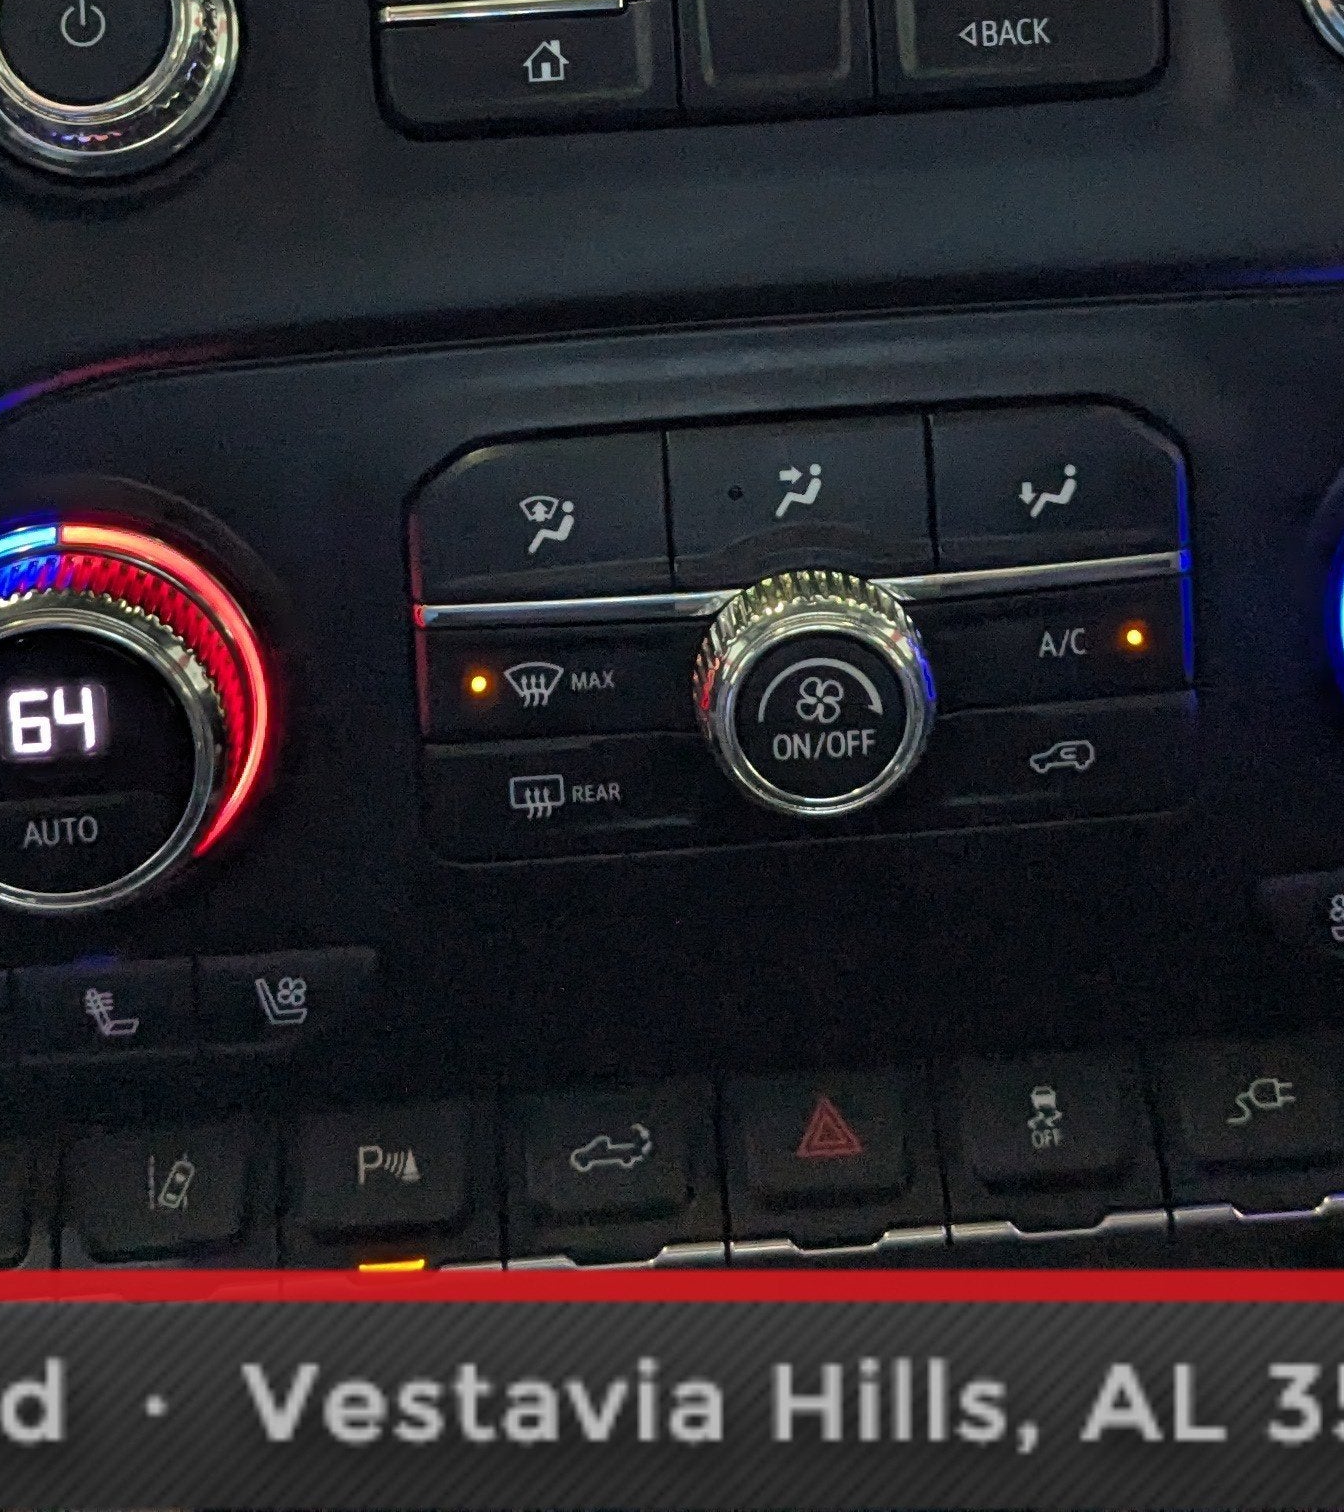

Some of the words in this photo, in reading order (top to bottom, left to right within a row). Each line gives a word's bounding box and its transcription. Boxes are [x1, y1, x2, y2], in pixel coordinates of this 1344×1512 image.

[981, 17, 1051, 47] BACK
[1039, 627, 1087, 658] A/C
[571, 670, 616, 691] MAX
[7, 686, 97, 755] 64
[772, 729, 876, 761] ON/OFF
[571, 782, 622, 803] REAR
[22, 815, 99, 849] AUTO
